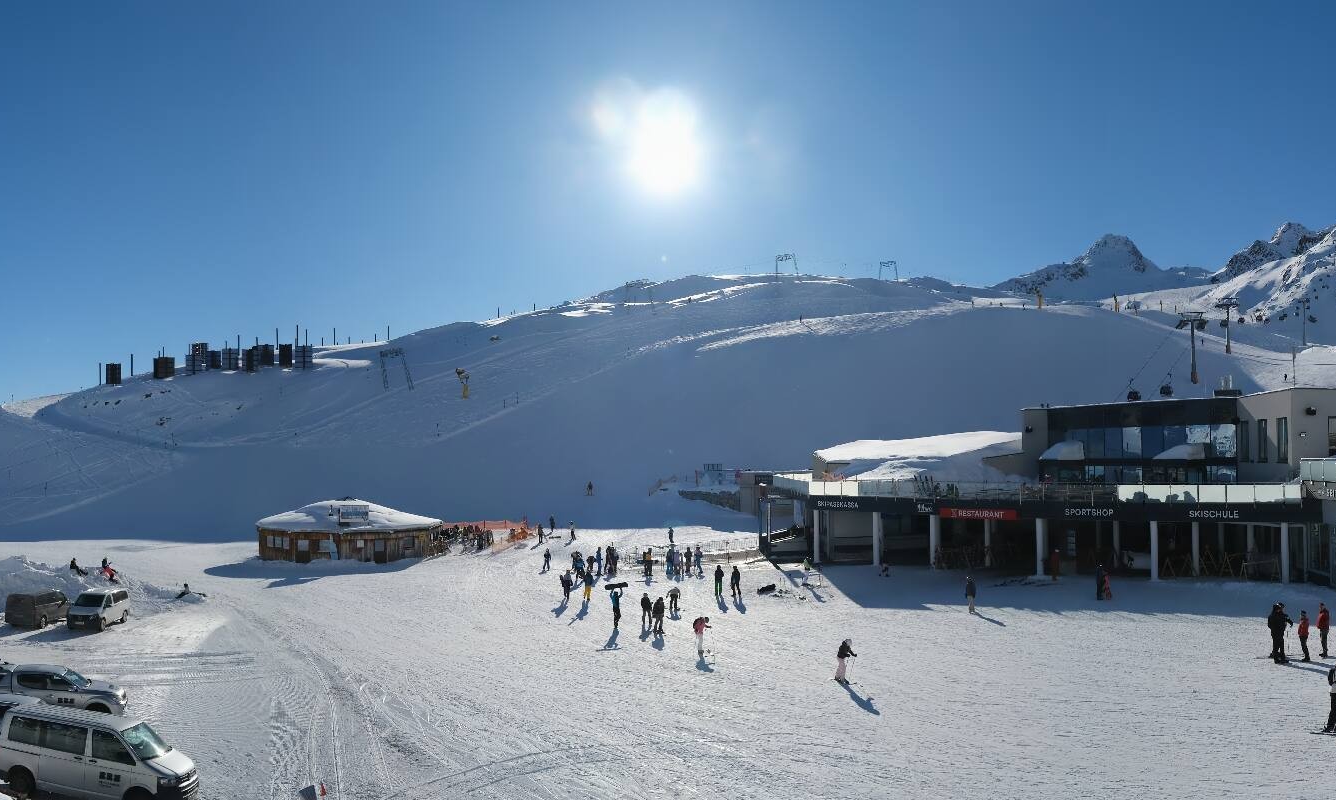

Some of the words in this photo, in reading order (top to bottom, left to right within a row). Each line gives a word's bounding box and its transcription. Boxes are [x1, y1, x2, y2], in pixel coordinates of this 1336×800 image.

[958, 510, 1005, 519] RESTAURANT
[1065, 508, 1114, 517] SPORTSHOP
[1189, 510, 1240, 519] SKISCHULE
